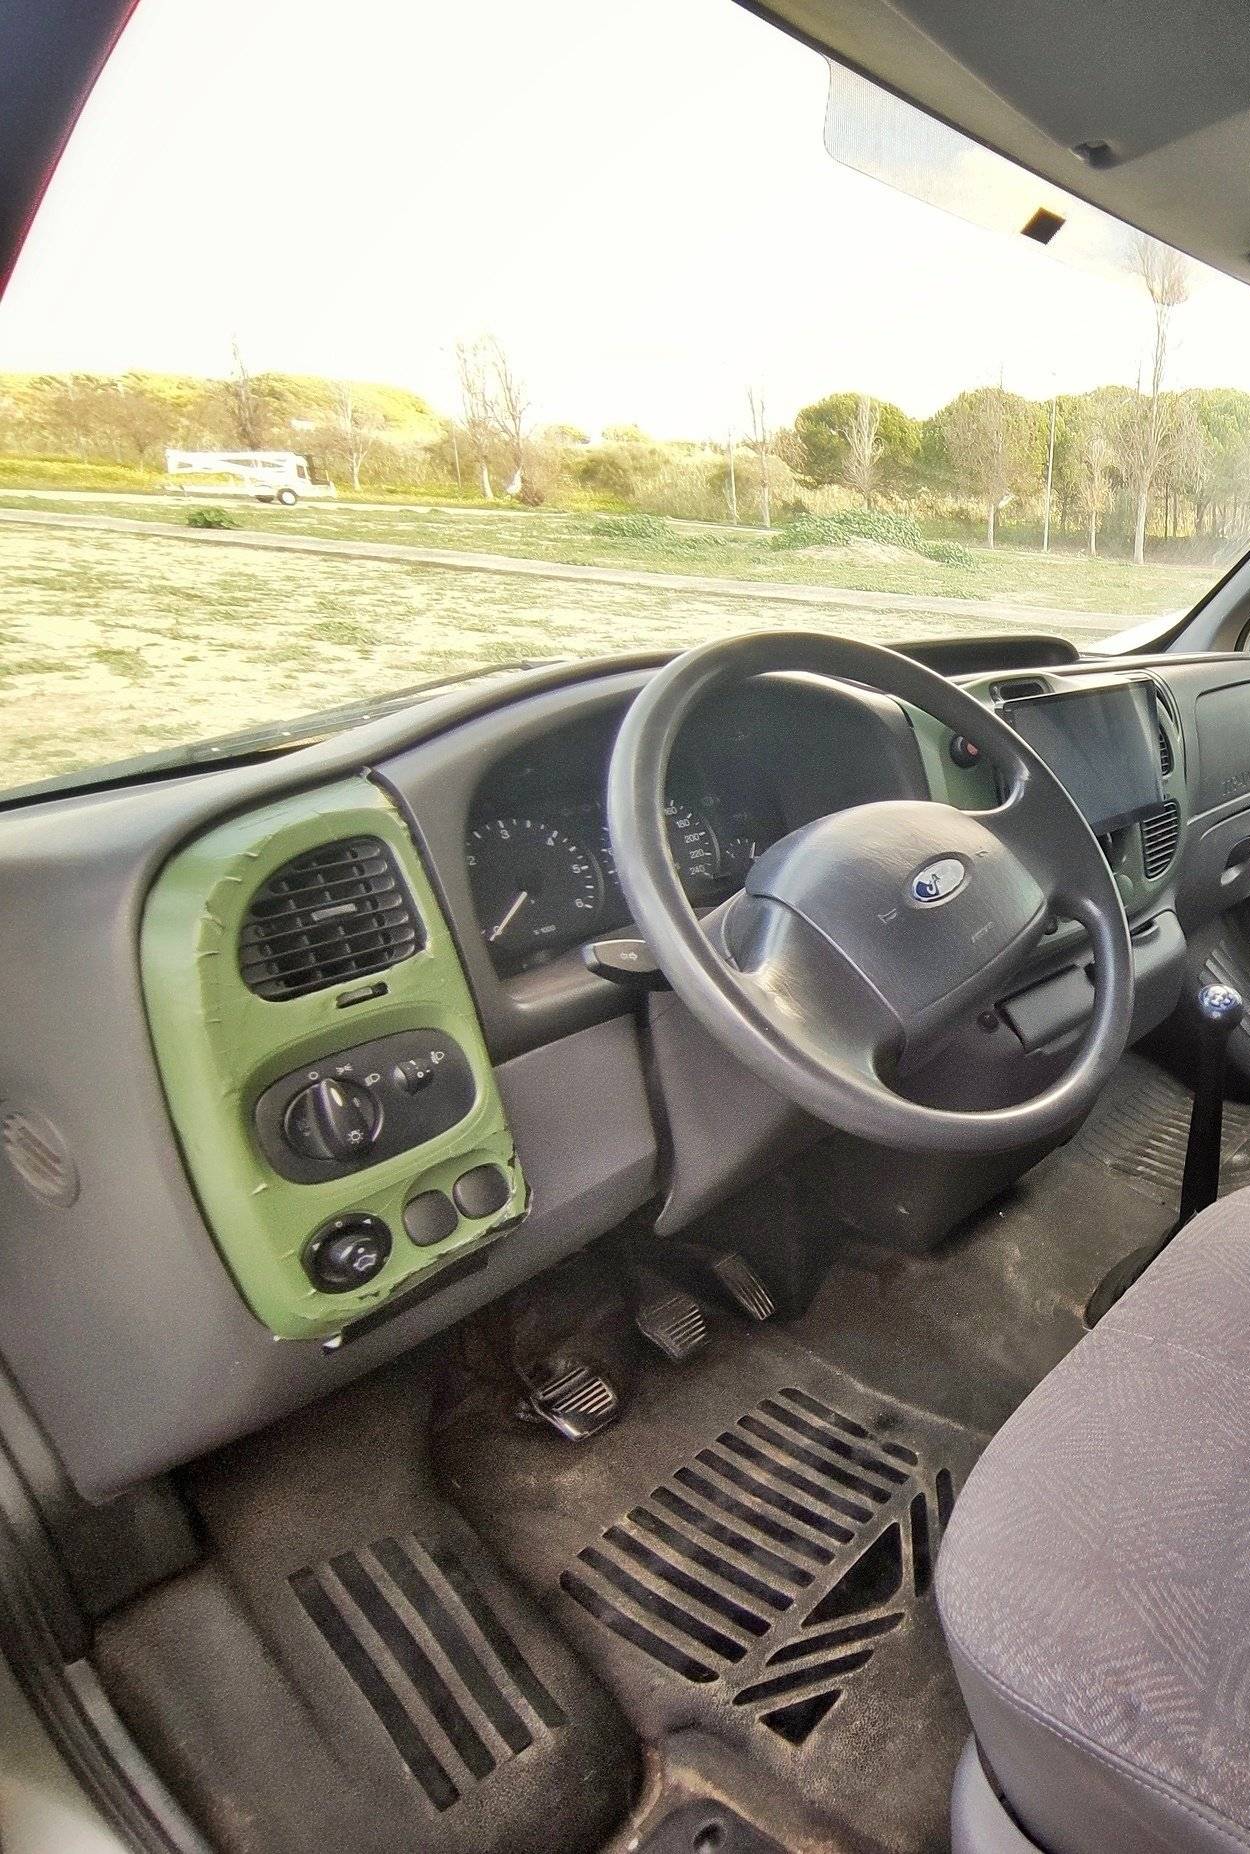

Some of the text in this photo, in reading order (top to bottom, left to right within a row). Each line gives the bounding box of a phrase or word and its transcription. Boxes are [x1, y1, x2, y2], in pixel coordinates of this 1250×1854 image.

[500, 829, 510, 839] 3
[684, 833, 700, 844] 200
[546, 837, 555, 847] 4
[689, 848, 705, 859] 220
[467, 855, 477, 866] 2
